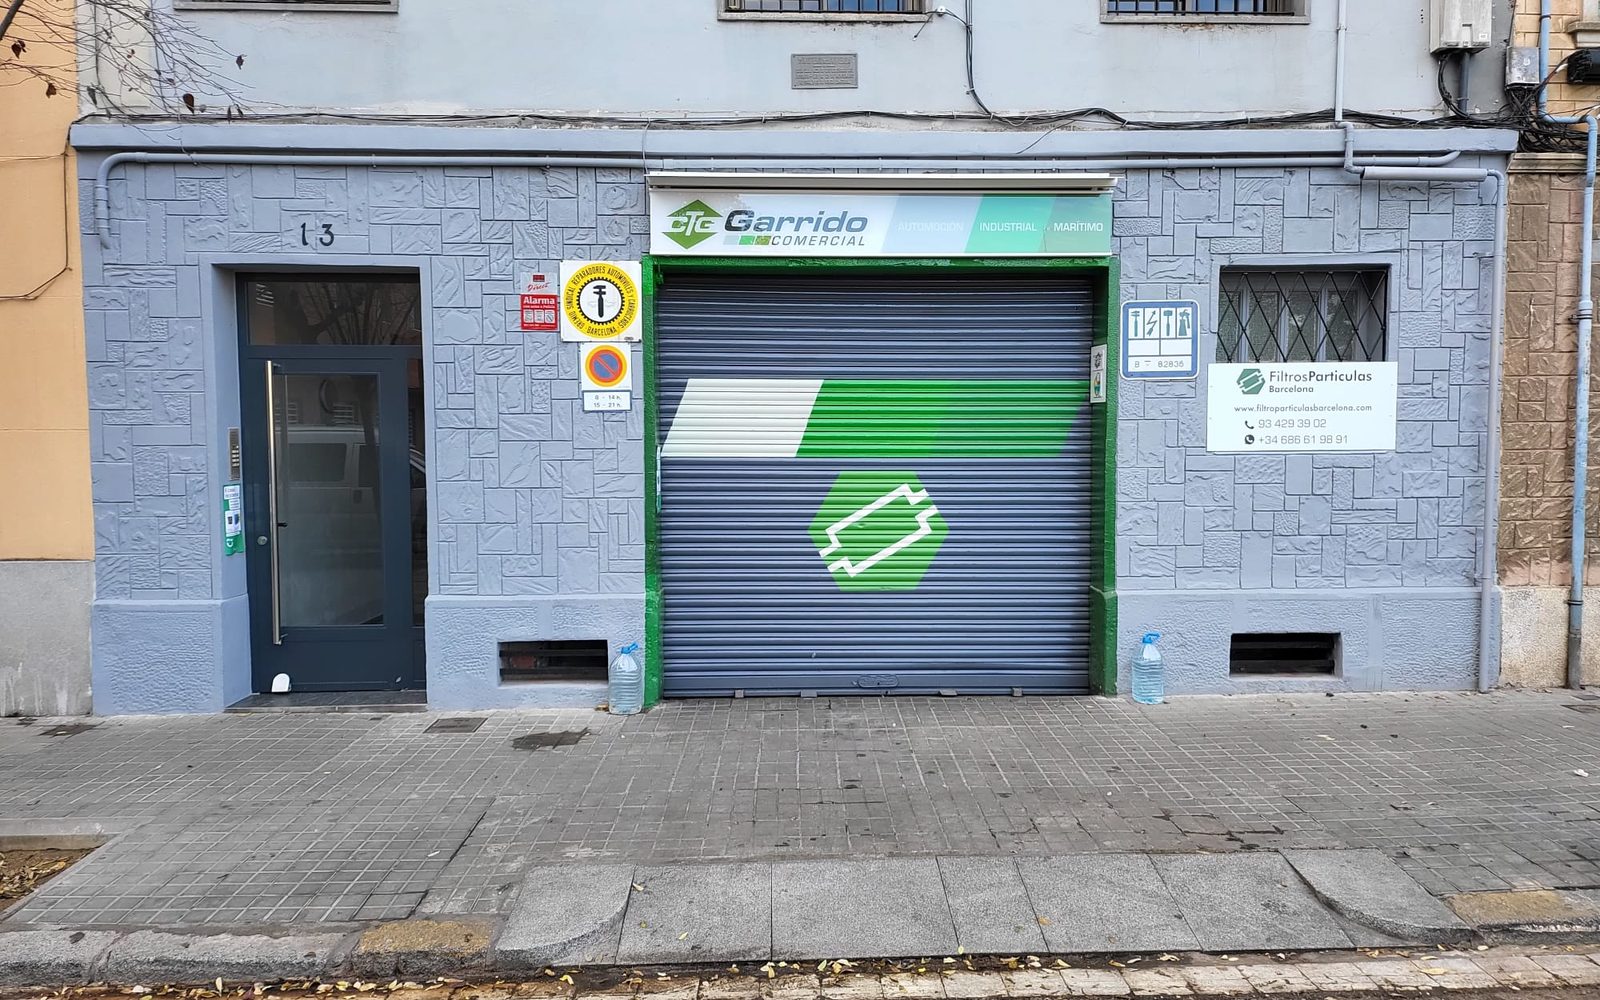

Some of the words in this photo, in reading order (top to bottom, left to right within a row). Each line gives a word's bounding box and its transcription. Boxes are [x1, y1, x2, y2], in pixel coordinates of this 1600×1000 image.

[724, 209, 869, 232] Garrido
[979, 222, 1037, 232] INDUSTRIAL
[1053, 221, 1104, 232] MARÍTIMO
[300, 222, 335, 247] 13
[771, 235, 865, 246] COMERCIAL
[571, 265, 606, 286] REPARADORES
[523, 295, 555, 304] Alarma
[587, 326, 617, 337] BARCELONA
[1269, 370, 1372, 382] FiltrosParticulas
[1269, 385, 1314, 393] Barcelona
[1234, 403, 1372, 413] www.filtroparticulasbarcelona.com
[1258, 419, 1272, 428] 93
[1274, 419, 1295, 428] 429
[1297, 419, 1311, 428] 39
[1313, 419, 1327, 428] 02
[1259, 435, 1278, 444] +34
[1280, 435, 1301, 444] 686
[1303, 435, 1316, 444] 61
[1319, 435, 1333, 444] 98
[1335, 435, 1348, 444] 91
